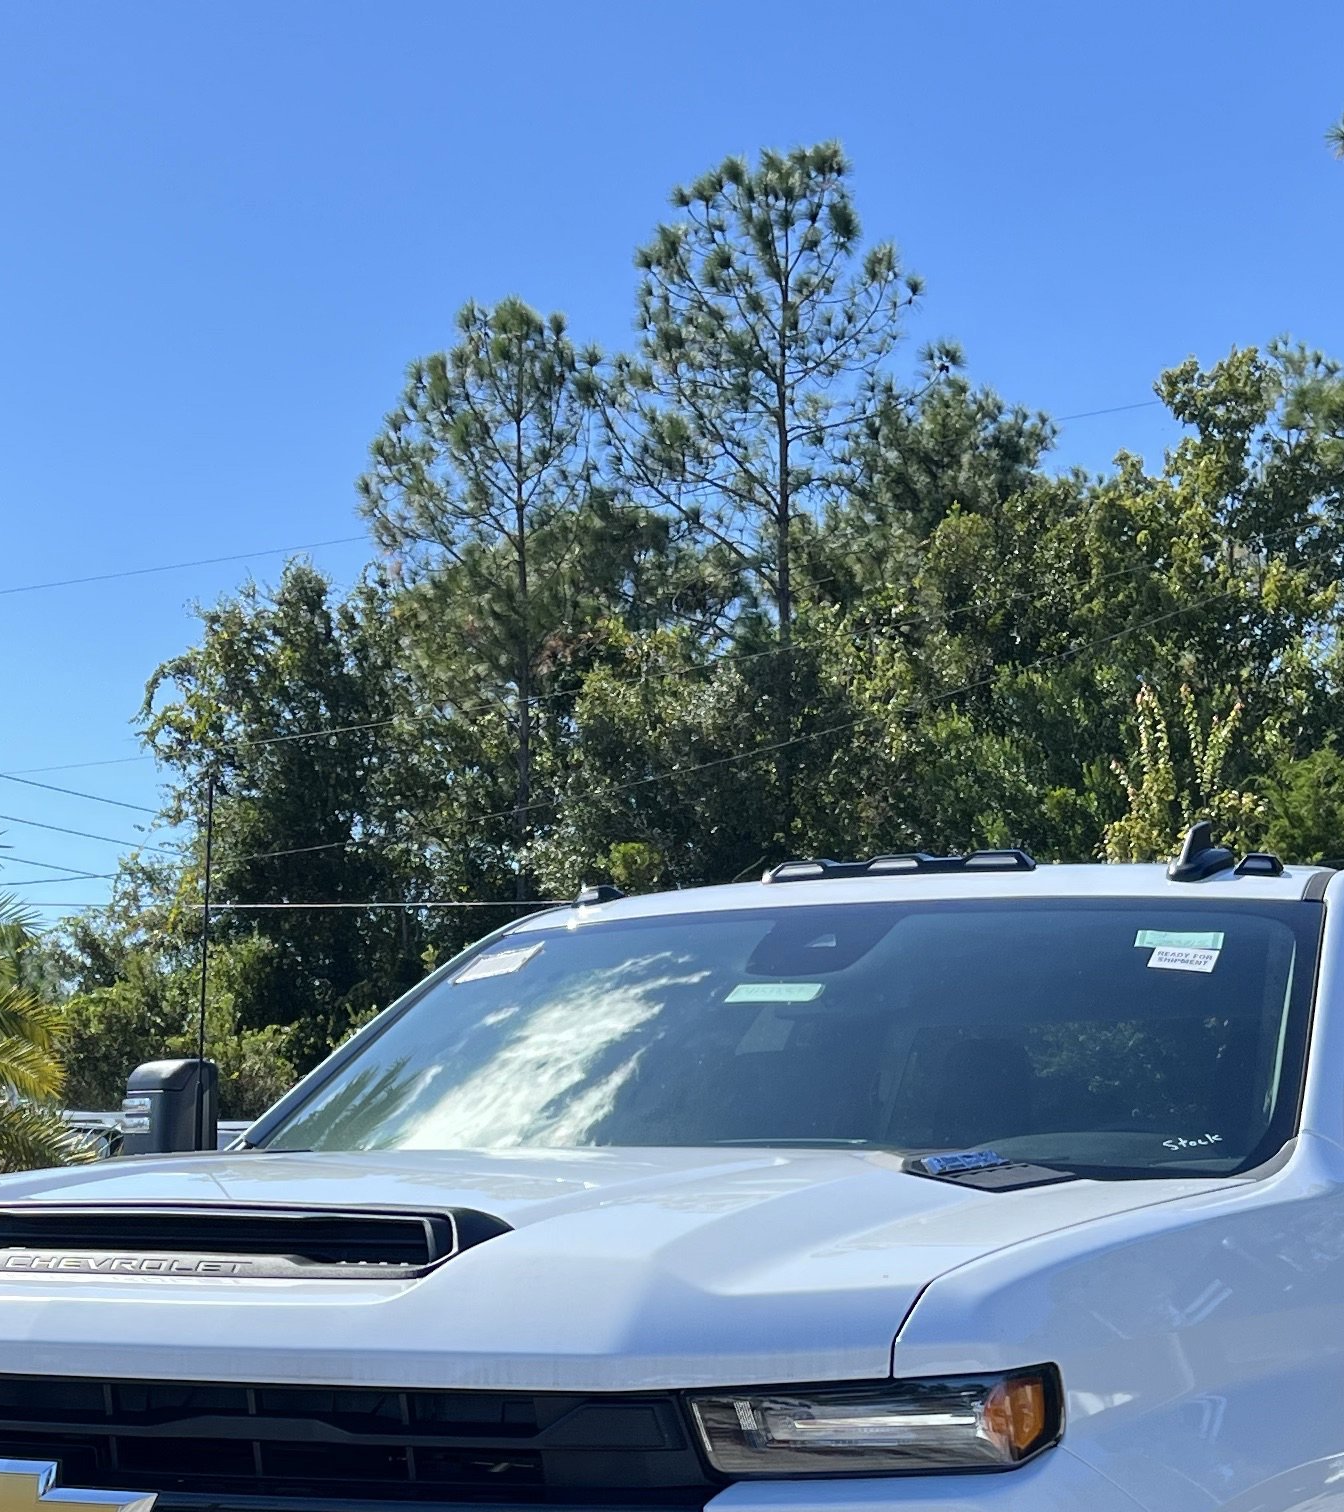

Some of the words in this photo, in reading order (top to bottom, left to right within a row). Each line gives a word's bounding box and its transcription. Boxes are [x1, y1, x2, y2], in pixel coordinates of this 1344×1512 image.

[1157, 950, 1191, 959] READY
[1193, 953, 1213, 961] FOR
[1157, 956, 1209, 966] SHIPMENT
[1162, 1133, 1223, 1151] Stock
[5, 1255, 253, 1274] CHEVROLET
